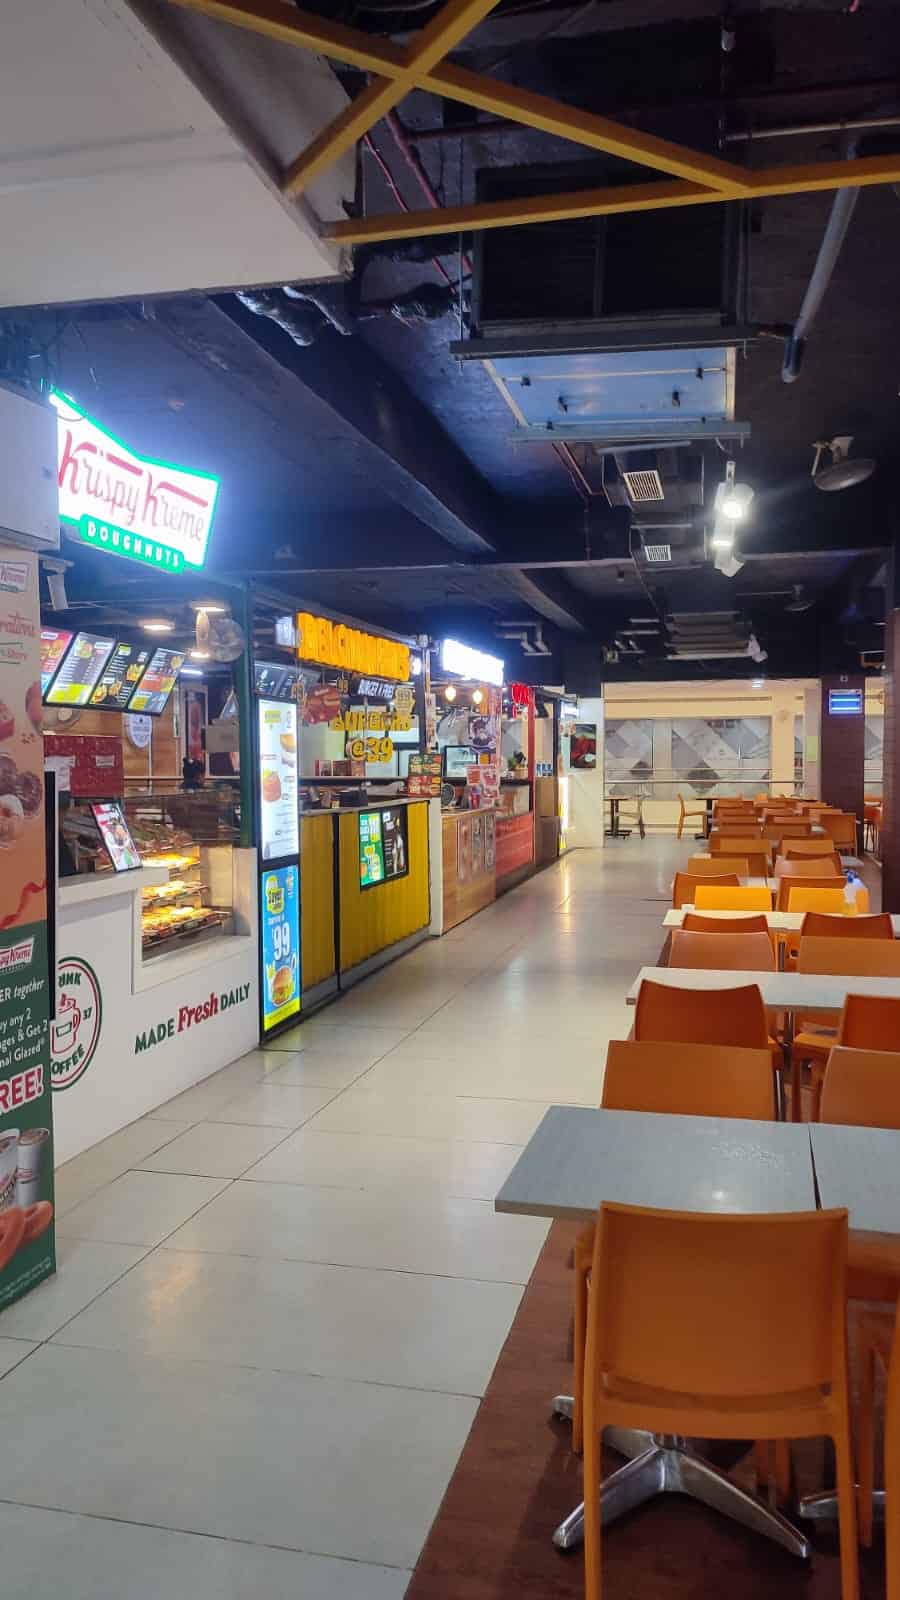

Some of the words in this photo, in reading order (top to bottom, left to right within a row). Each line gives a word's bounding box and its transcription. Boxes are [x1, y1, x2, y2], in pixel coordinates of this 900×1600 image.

[58, 429, 143, 526] Krispy
[142, 470, 209, 541] Kreme
[87, 520, 179, 568] DOUGHNUTS
[14, 977, 45, 1000] together
[9, 1014, 25, 1028] any
[26, 1007, 31, 1020] 2
[17, 1028, 25, 1042] &
[26, 1024, 41, 1039] Get
[42, 1019, 48, 1033] 2
[134, 1018, 175, 1055] MADE
[177, 992, 219, 1033] Fresh
[220, 982, 251, 1012] DAILY
[50, 1043, 85, 1075] OFFEE
